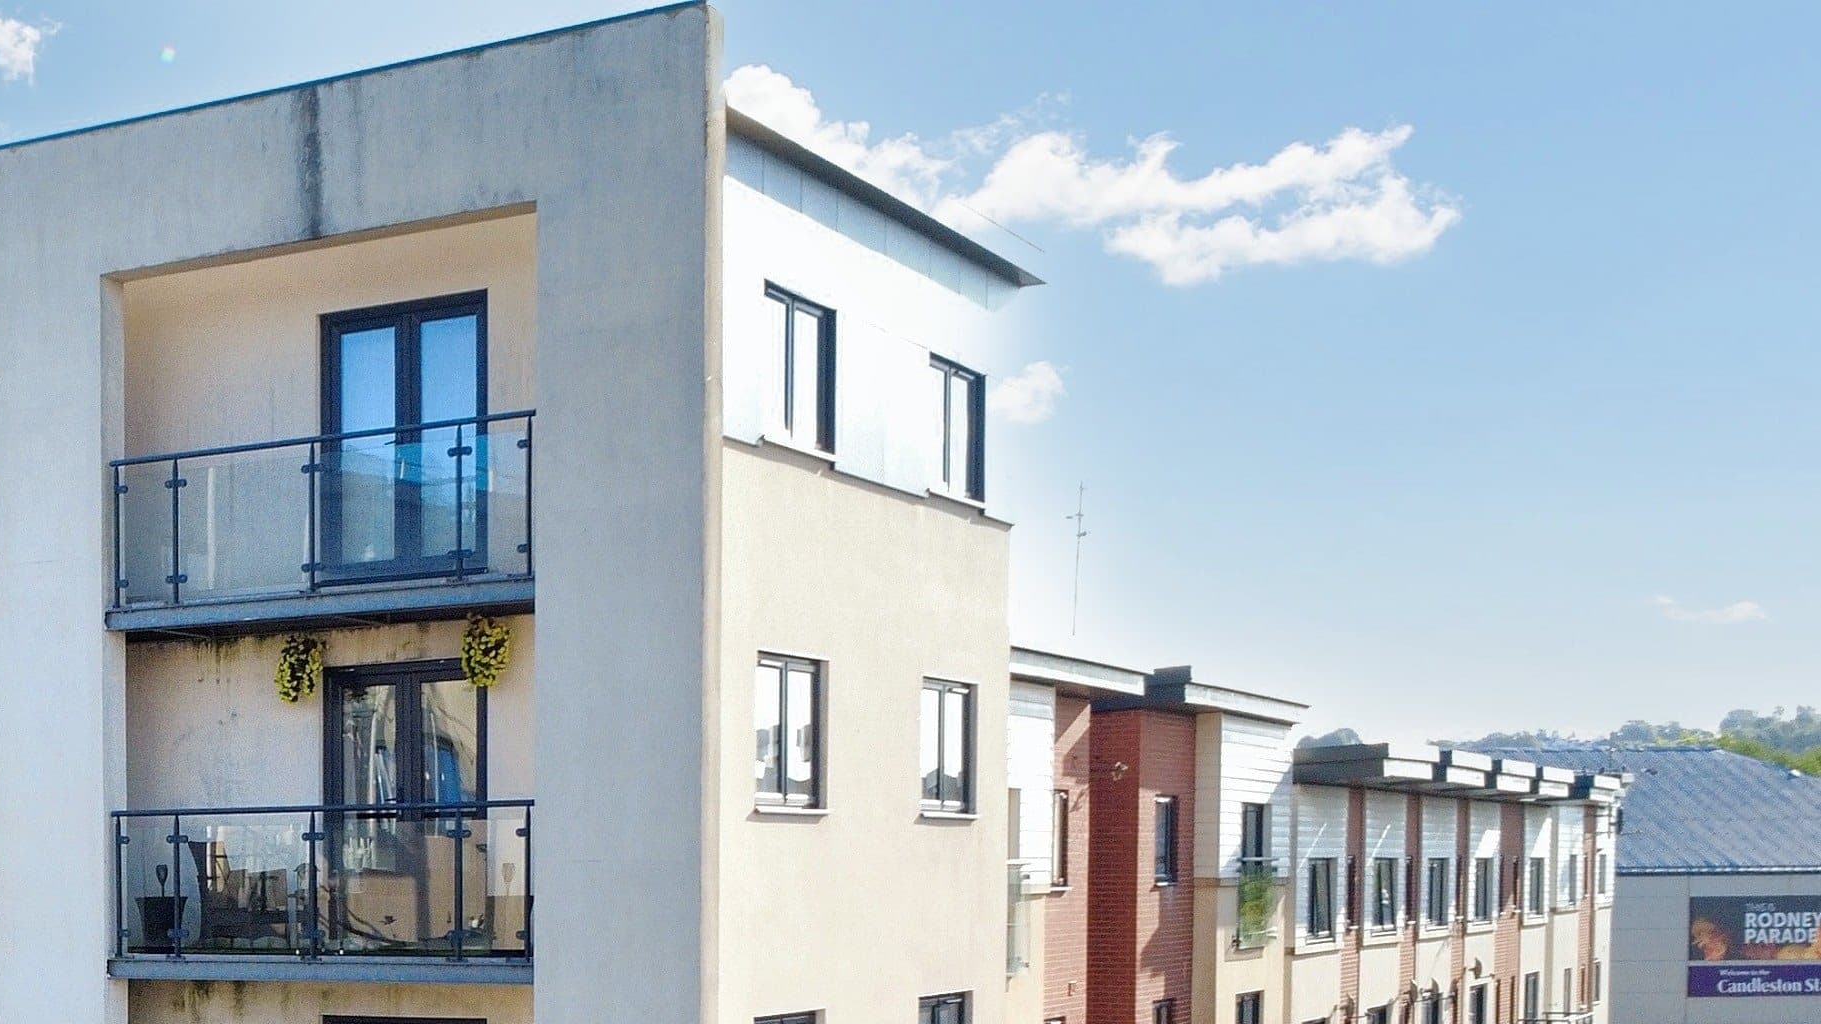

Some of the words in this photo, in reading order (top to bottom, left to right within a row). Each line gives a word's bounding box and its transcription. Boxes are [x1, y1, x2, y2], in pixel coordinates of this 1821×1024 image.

[1744, 911, 1821, 928] RODNEY
[1744, 927, 1817, 944] PARADE
[1804, 977, 1821, 993] St
